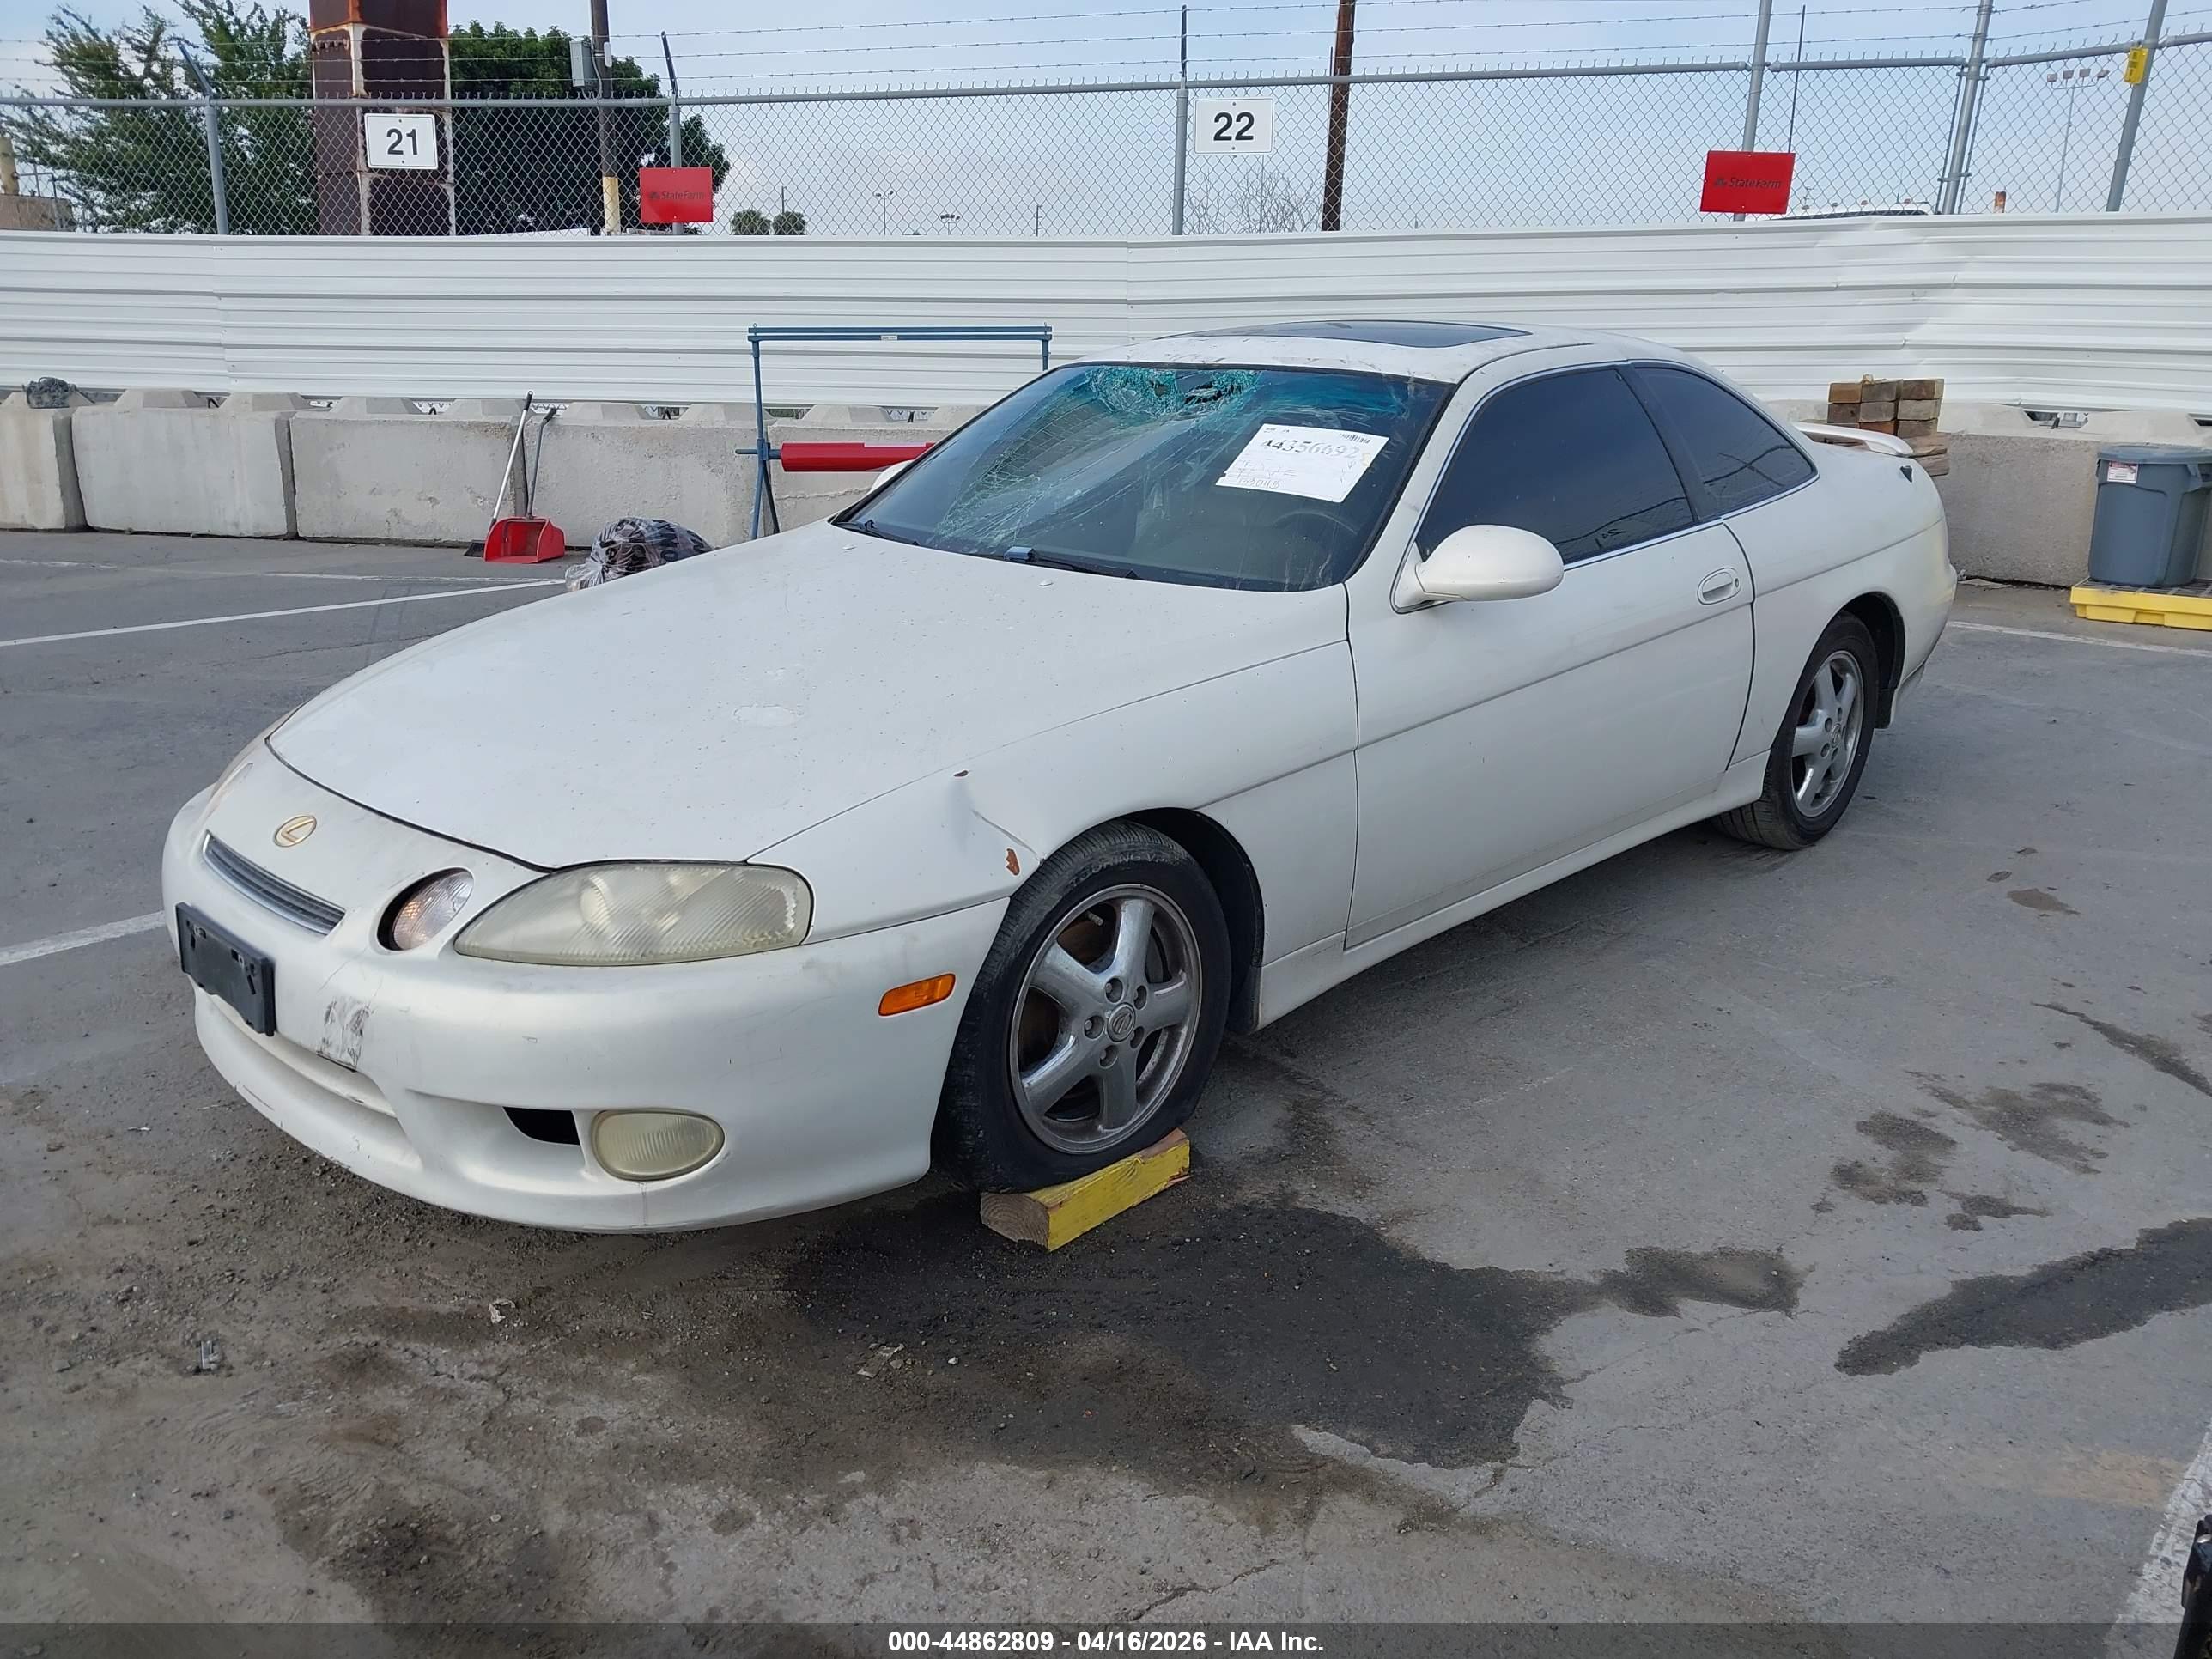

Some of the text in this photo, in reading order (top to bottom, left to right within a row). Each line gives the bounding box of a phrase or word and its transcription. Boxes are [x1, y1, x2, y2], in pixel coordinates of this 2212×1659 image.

[1213, 112, 1255, 142] 22
[386, 128, 418, 155] 21
[1729, 176, 1782, 189] StateFarm
